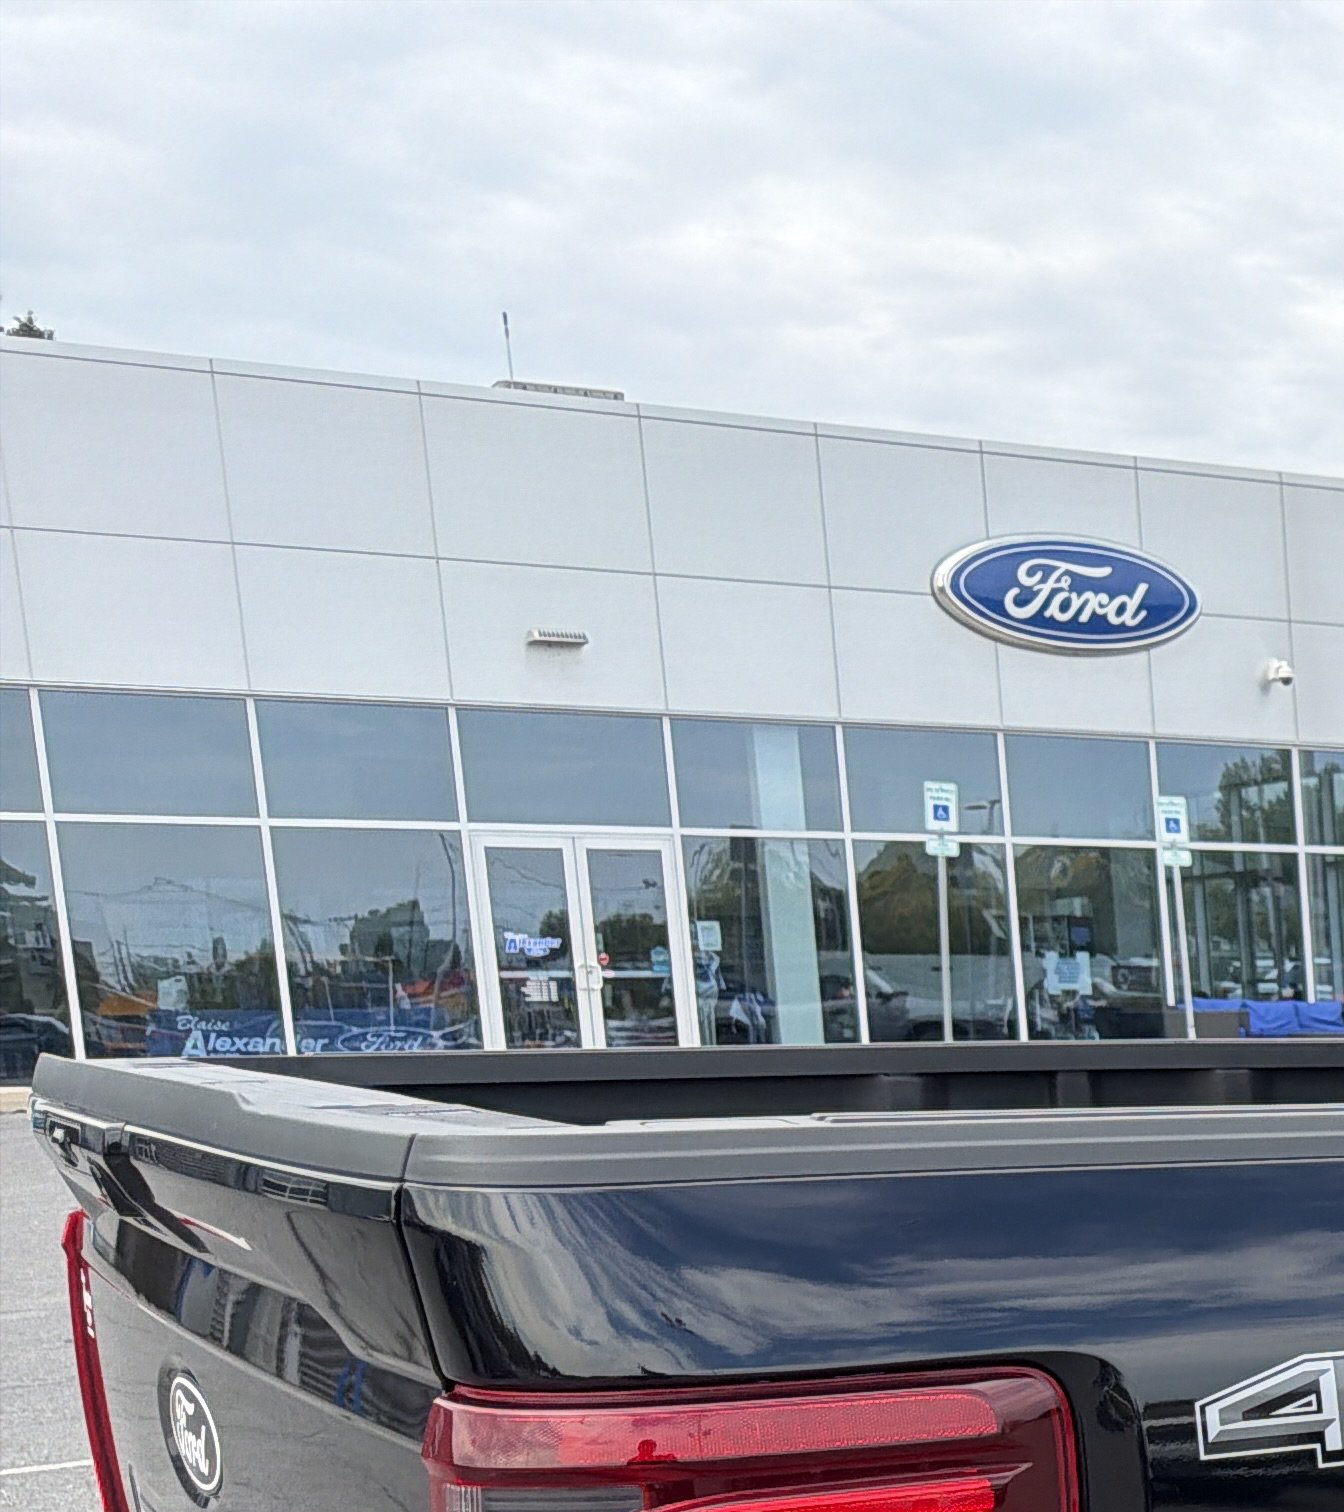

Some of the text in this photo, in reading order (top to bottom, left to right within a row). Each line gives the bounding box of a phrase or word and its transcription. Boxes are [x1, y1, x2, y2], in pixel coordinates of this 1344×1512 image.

[1003, 558, 1149, 627] Ford
[181, 1030, 330, 1056] Alexaner
[360, 1031, 423, 1052] Ford
[175, 1388, 209, 1477] Ford
